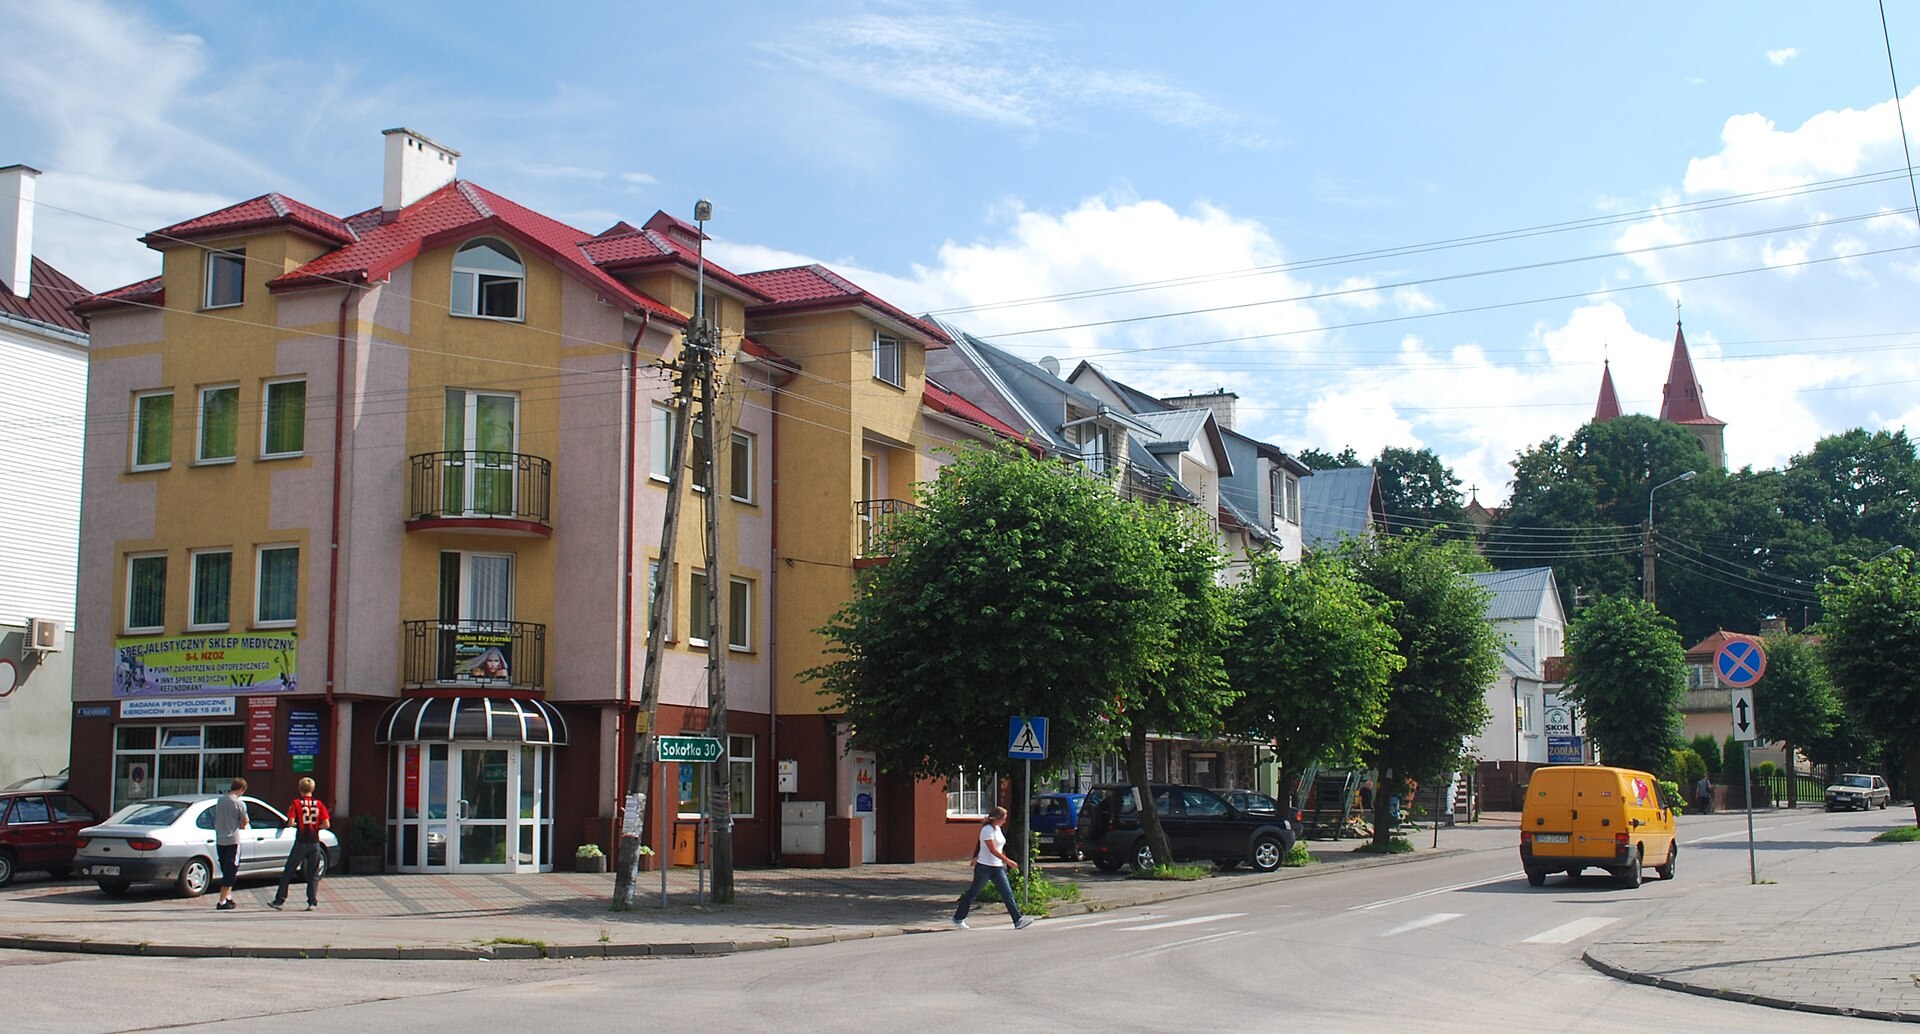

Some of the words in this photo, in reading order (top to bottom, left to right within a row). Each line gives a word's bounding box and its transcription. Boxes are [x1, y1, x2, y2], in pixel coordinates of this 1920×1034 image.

[478, 635, 512, 643] Fryzjerski
[120, 638, 206, 657] SPECJALISTYCZNY
[208, 637, 239, 649] SKLEP
[201, 651, 225, 660] NZOZ
[154, 665, 172, 674] PUNKT
[174, 663, 215, 673] ZAOPATRZENIA
[217, 662, 270, 671] ORTOPEDYCZNEGO
[160, 676, 174, 685] INNY
[197, 674, 228, 683] MEDYCZNY
[230, 673, 256, 688] NFZ
[160, 684, 203, 692] REFUNDOWANY
[703, 743, 716, 757] 30
[1548, 746, 1580, 756] ZODIAK
[301, 805, 319, 825] 22
